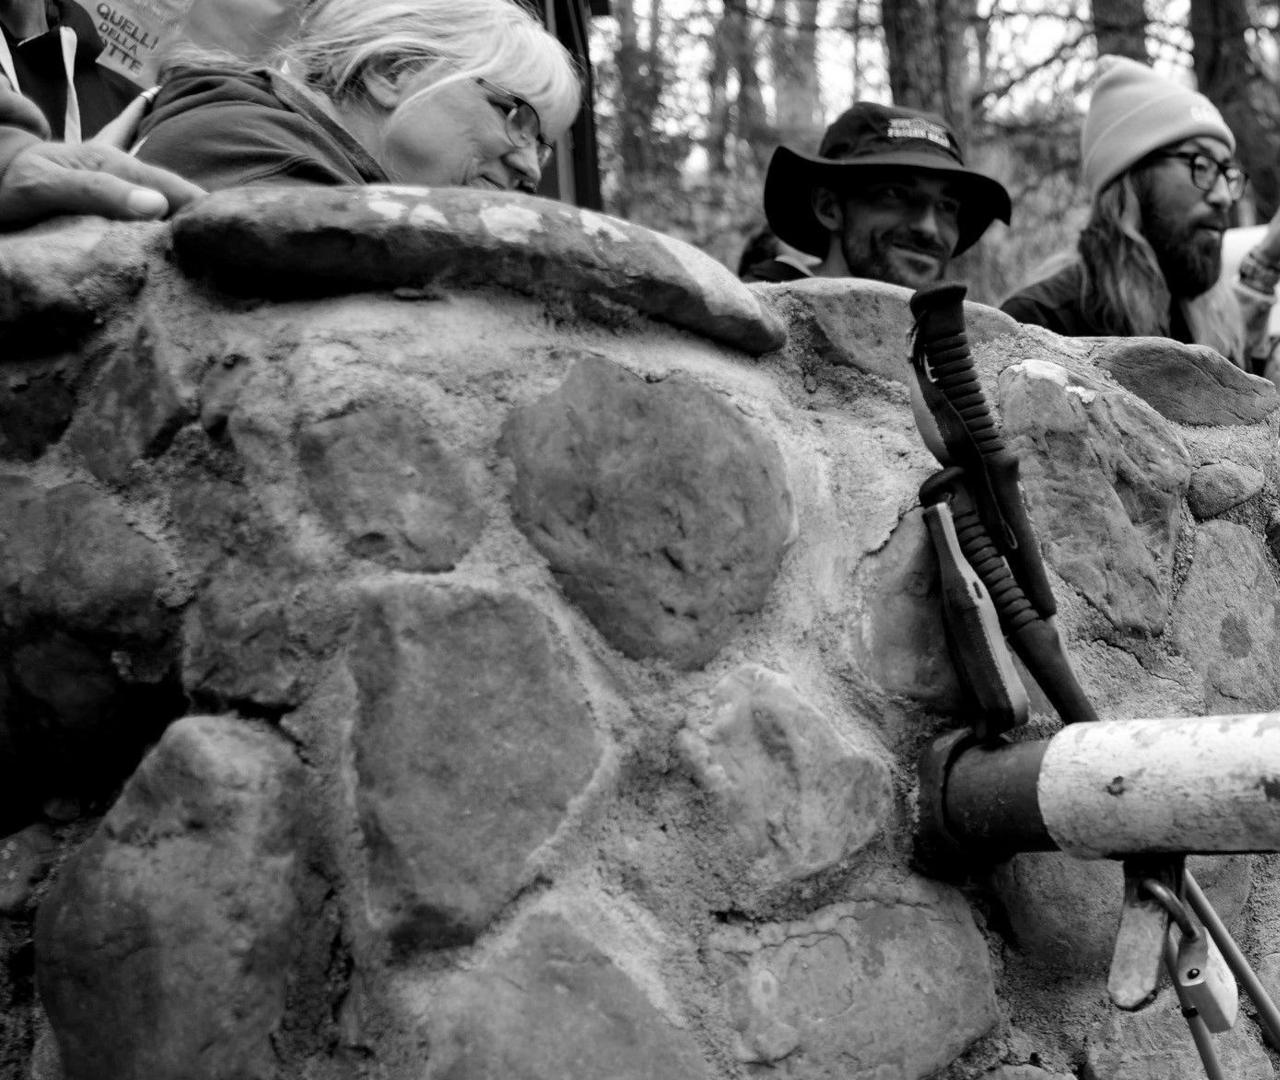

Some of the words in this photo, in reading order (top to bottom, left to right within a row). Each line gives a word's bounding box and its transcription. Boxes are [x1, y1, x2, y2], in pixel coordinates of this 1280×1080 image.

[97, 2, 159, 50] QUELLI
[99, 22, 139, 57] DELLA
[101, 39, 143, 73] TTE
